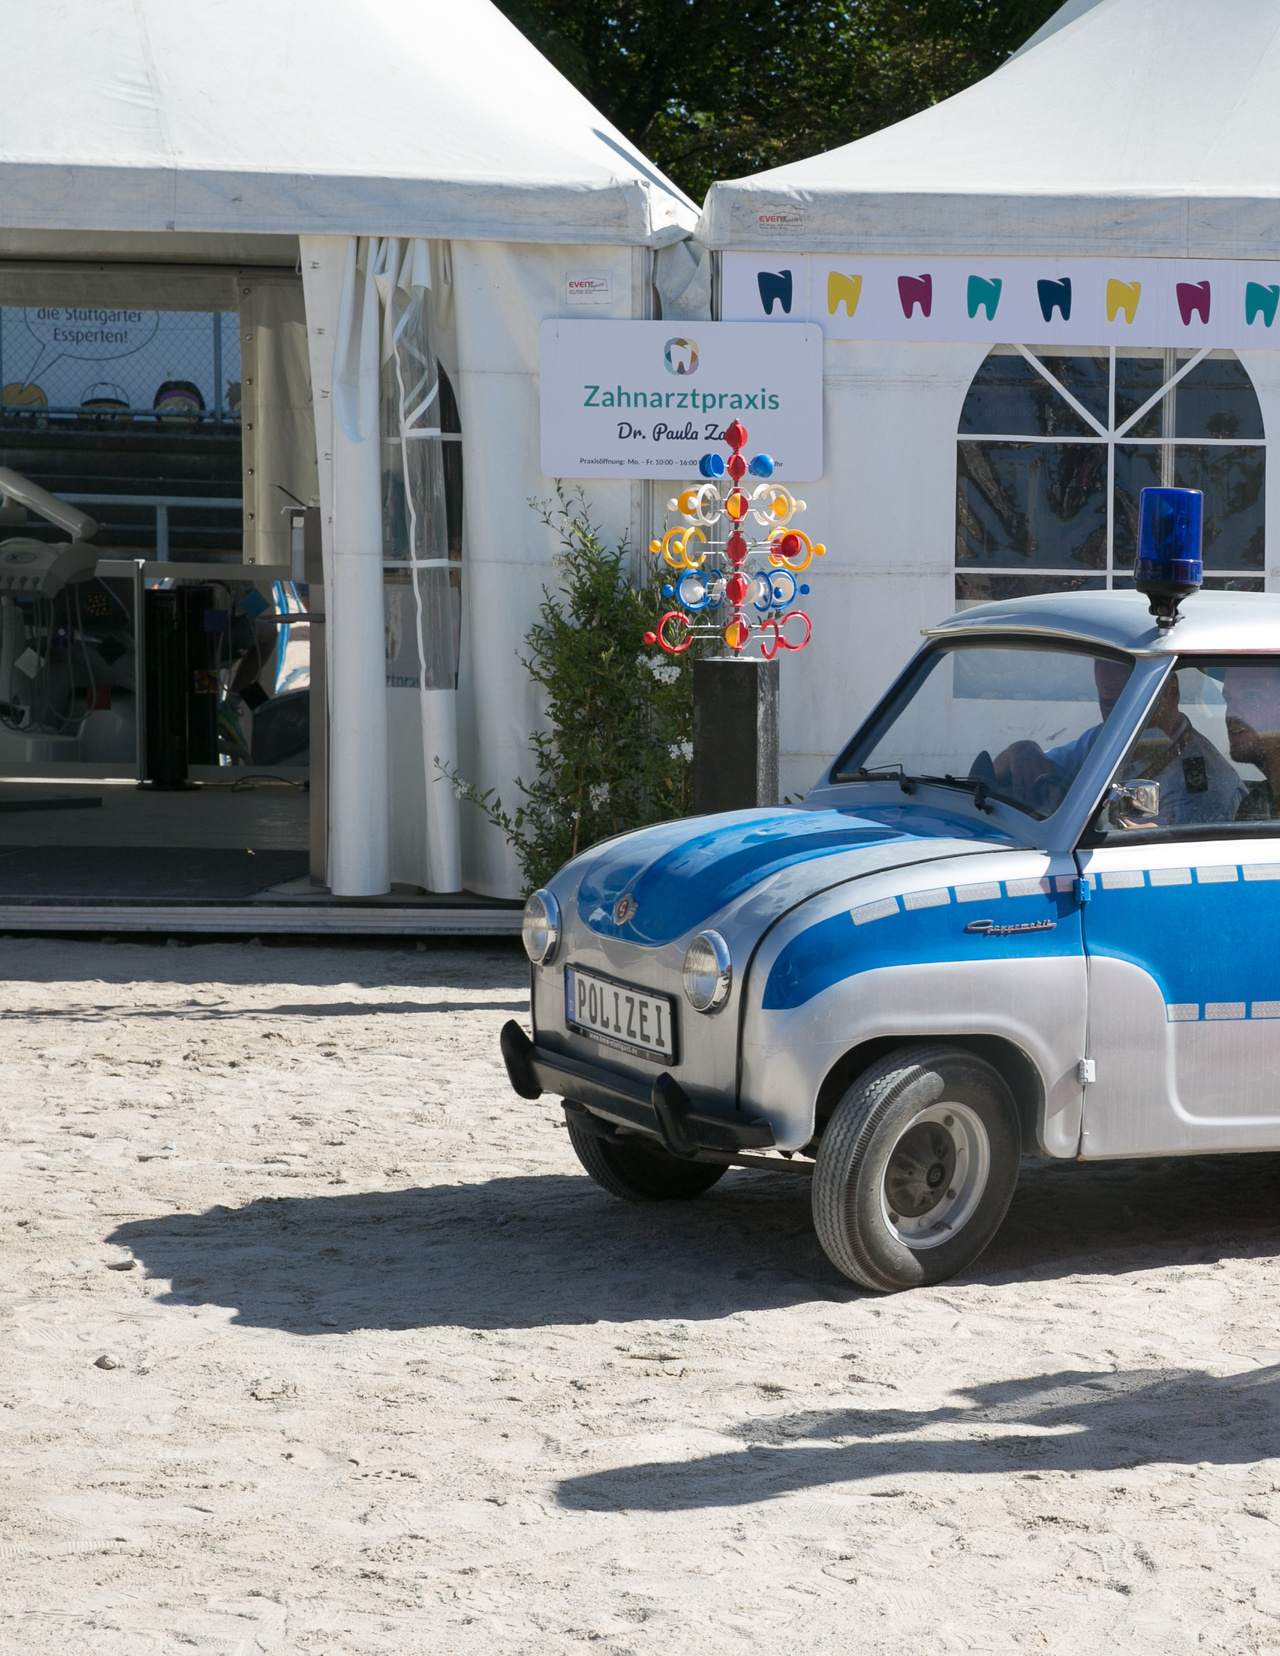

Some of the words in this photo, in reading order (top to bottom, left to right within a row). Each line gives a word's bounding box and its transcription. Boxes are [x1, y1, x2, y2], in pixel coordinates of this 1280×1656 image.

[37, 308, 60, 320] die
[65, 308, 142, 325] Stuttgarter
[53, 327, 128, 345] Essperten!
[583, 385, 780, 413] Zahnarztpraxis
[617, 422, 646, 440] Dr.
[652, 421, 699, 442] Paula
[704, 423, 727, 441] Za
[579, 457, 625, 466] Praxisöffnung:
[577, 978, 665, 1048] POLIZEI
